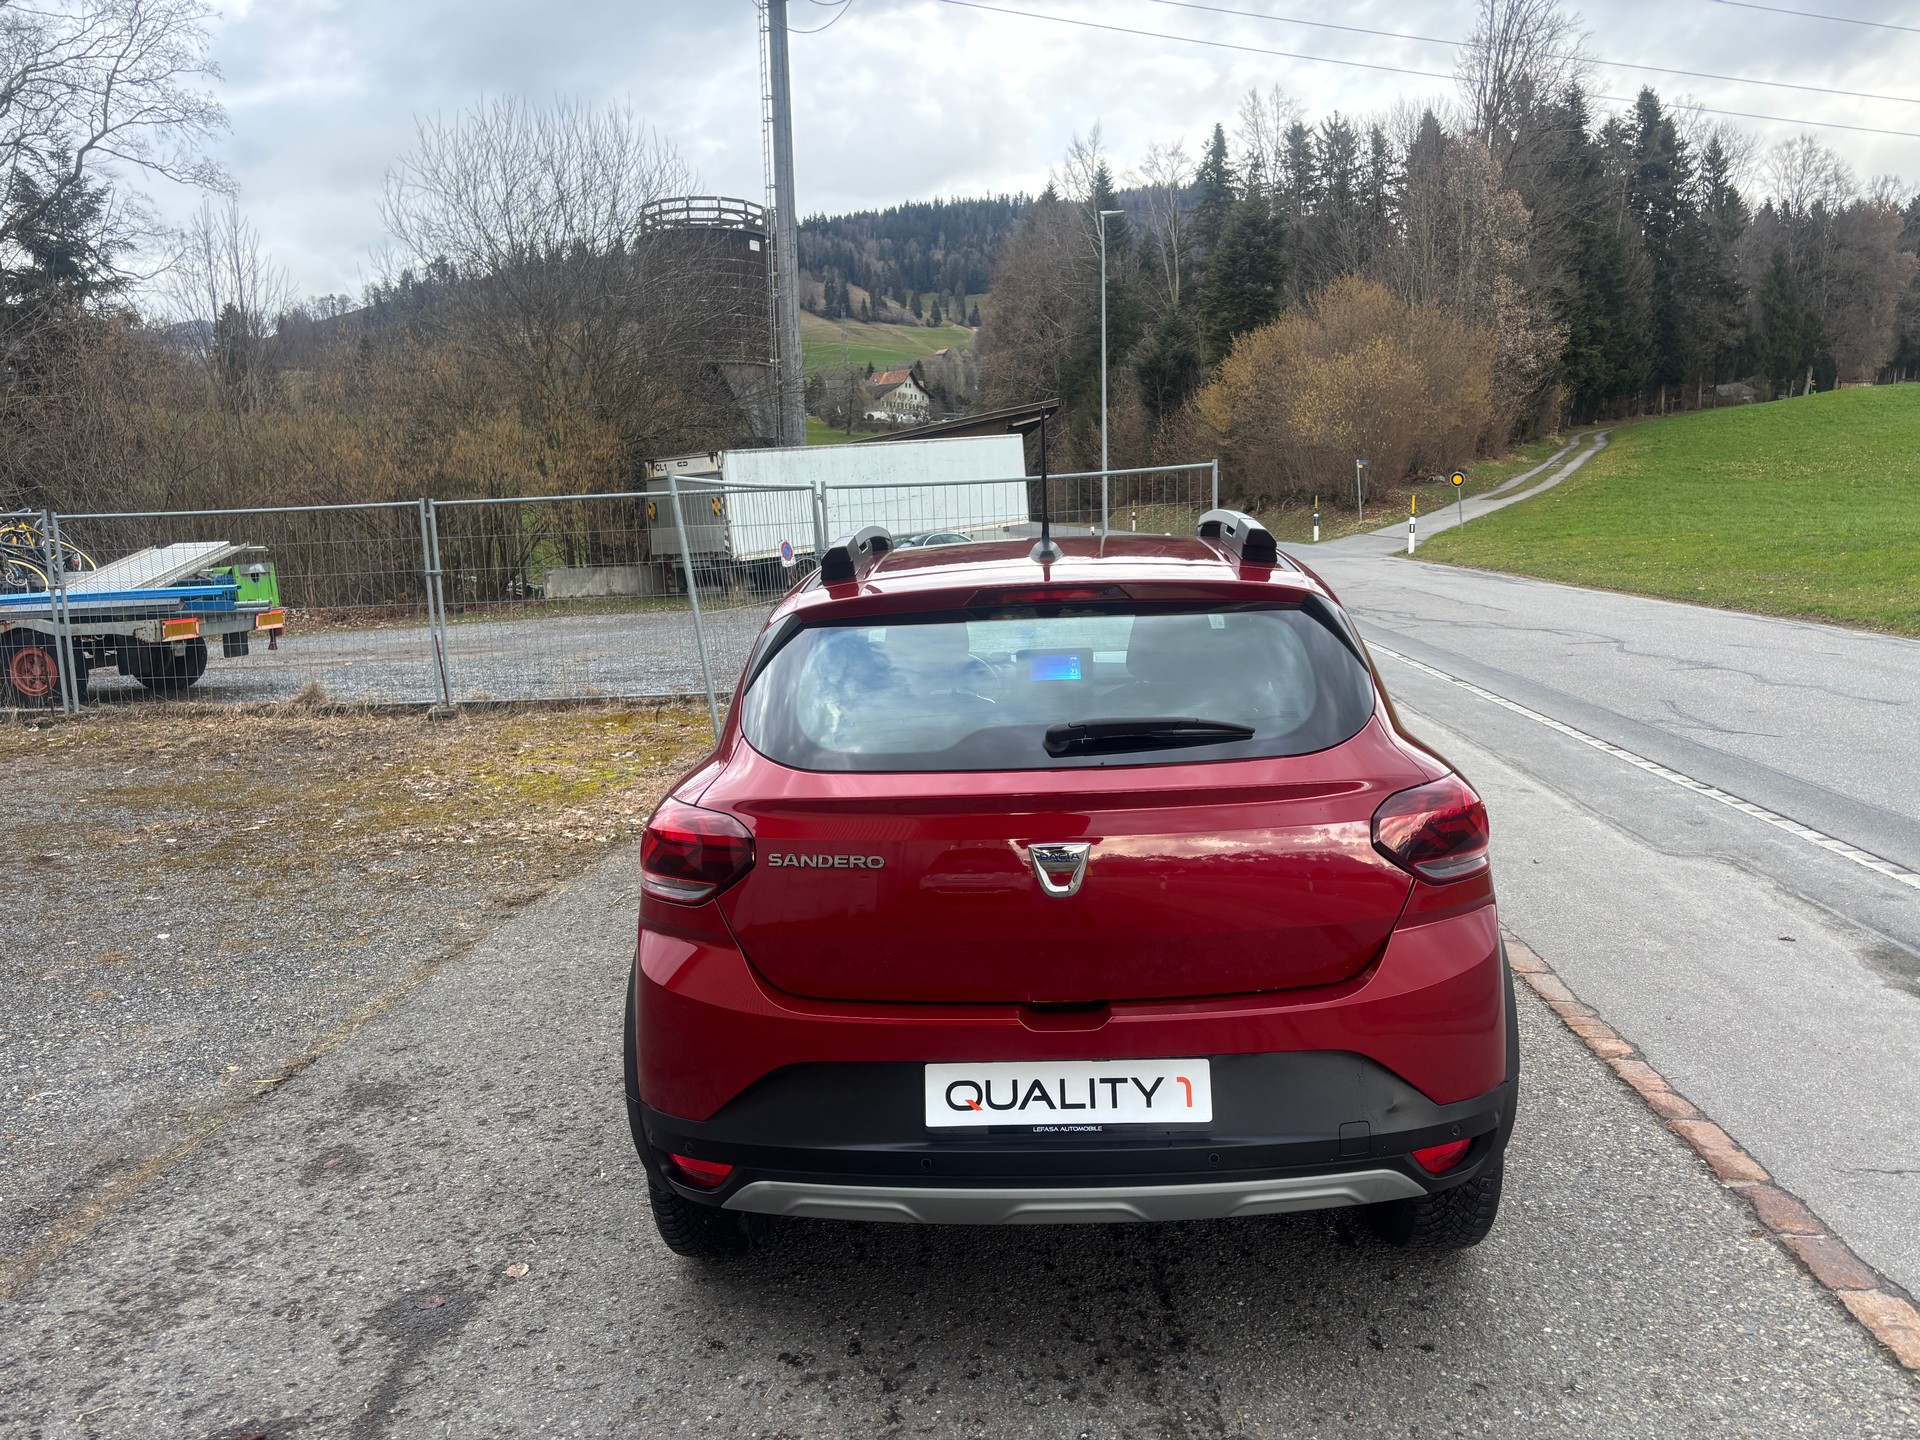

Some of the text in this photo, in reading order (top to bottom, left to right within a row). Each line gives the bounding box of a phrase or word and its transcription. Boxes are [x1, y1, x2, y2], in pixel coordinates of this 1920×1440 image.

[768, 853, 885, 869] SANDERO
[945, 1076, 1193, 1111] QUALITY 1
